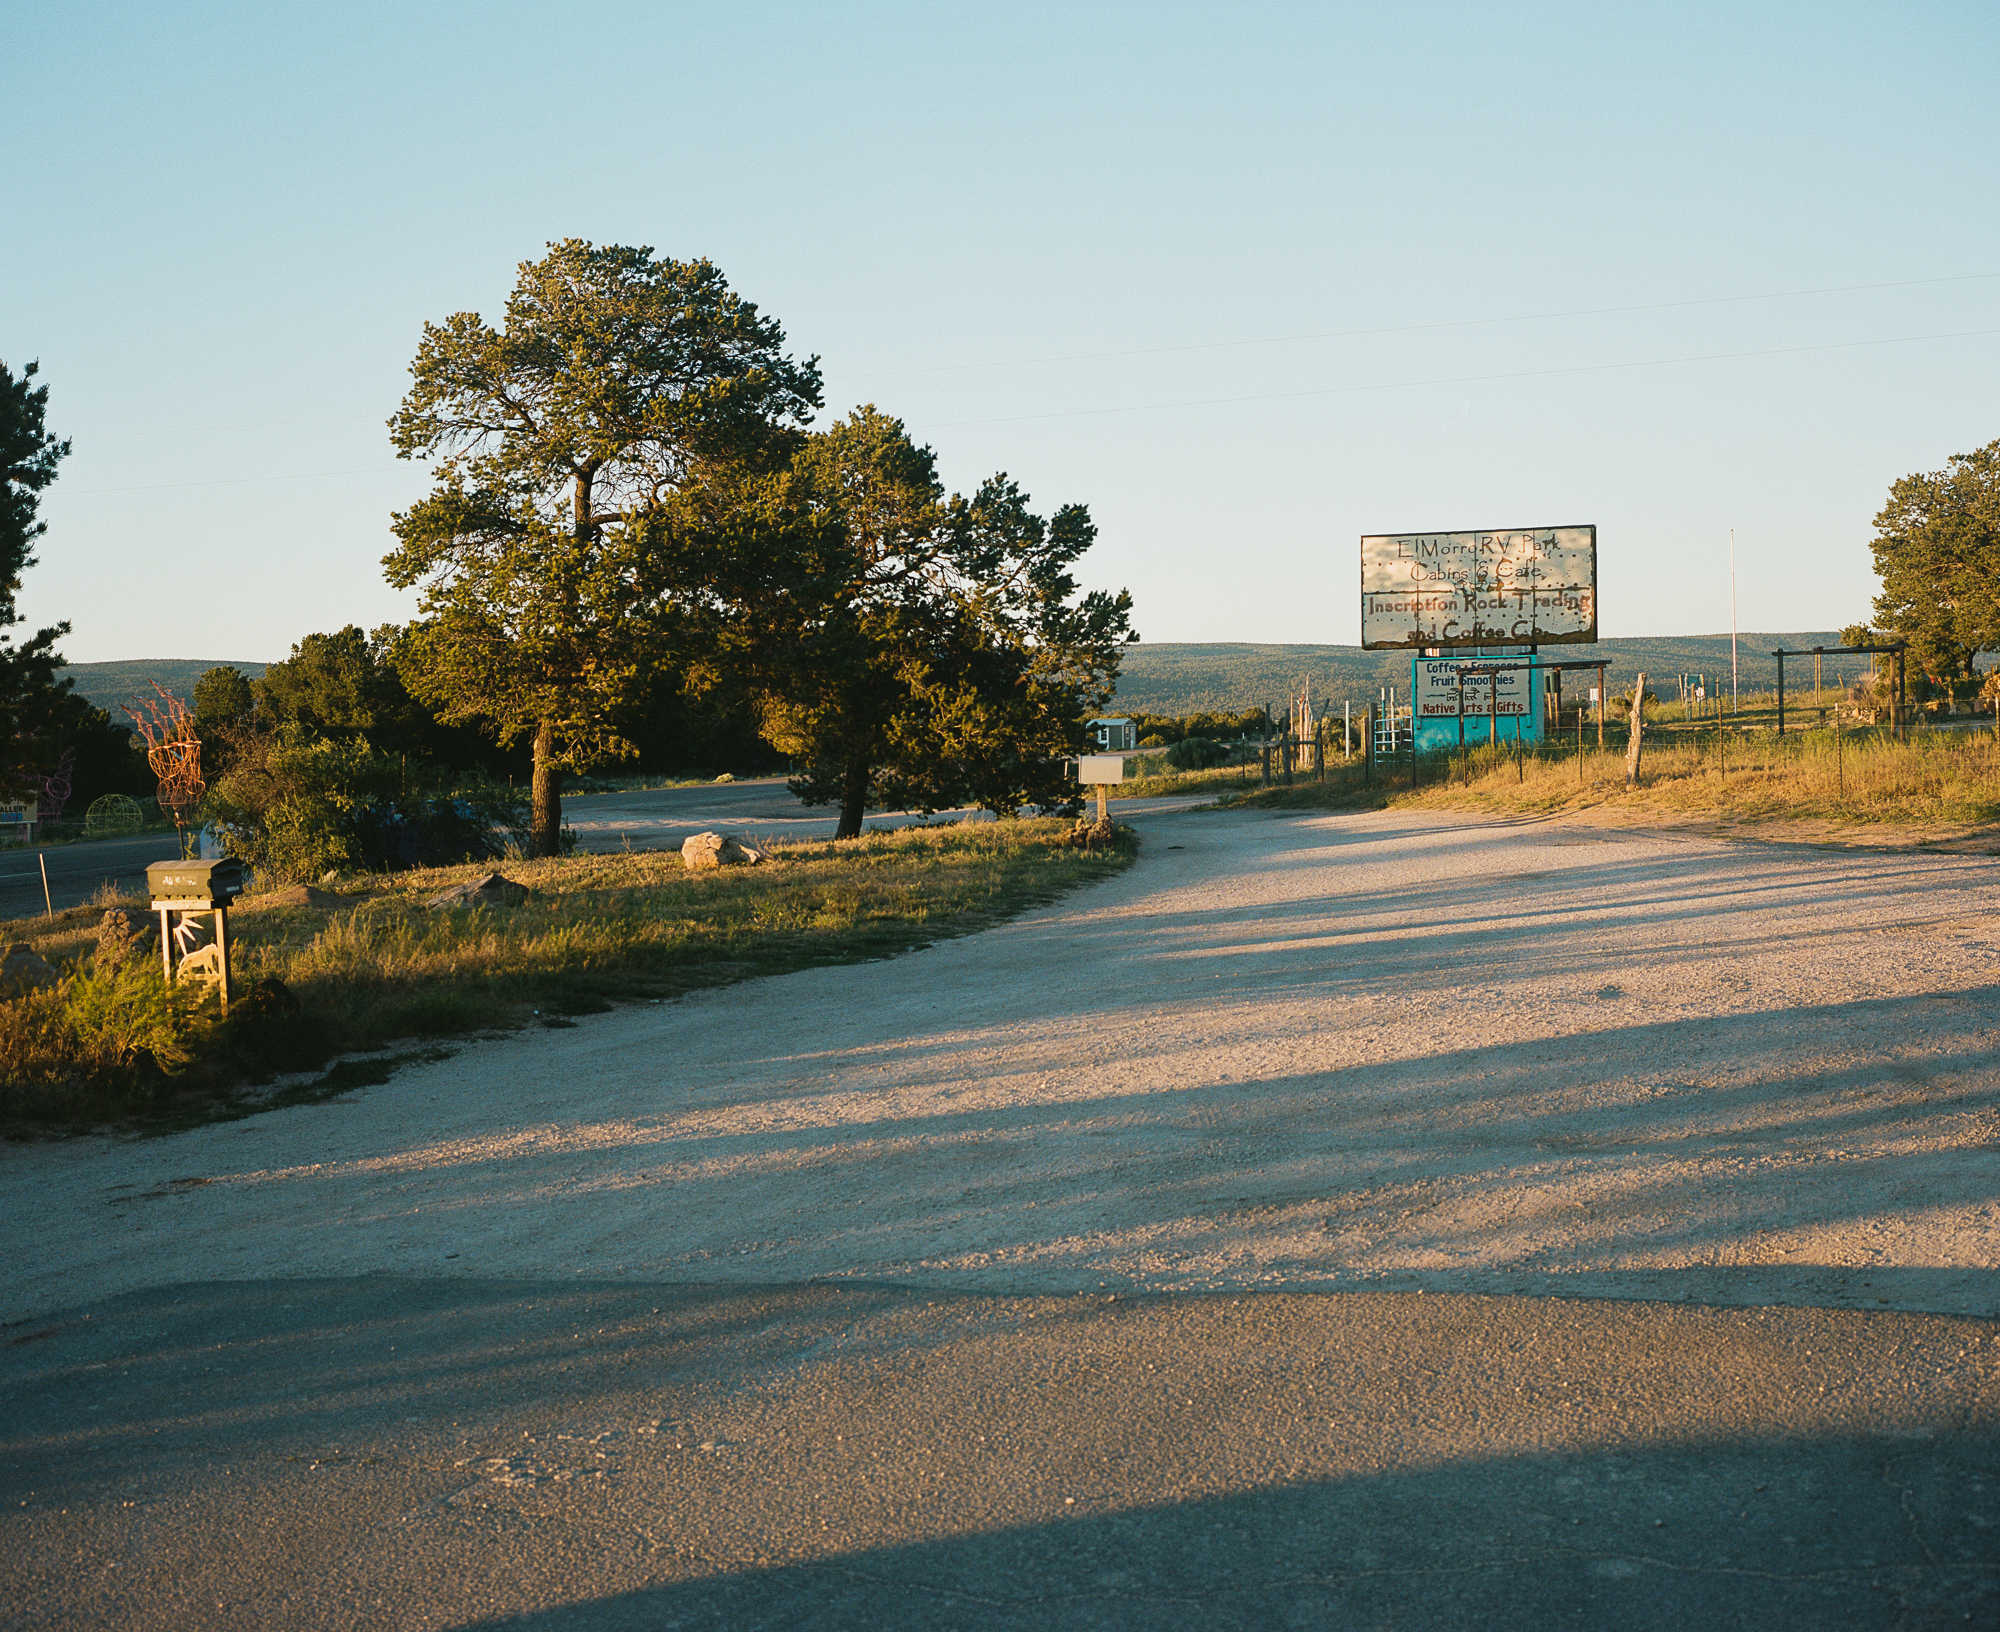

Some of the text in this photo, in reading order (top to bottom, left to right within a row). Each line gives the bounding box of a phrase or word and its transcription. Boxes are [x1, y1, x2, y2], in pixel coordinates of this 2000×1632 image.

[1421, 539, 1477, 557] Morro
[1481, 536, 1512, 555] RV
[1522, 533, 1561, 553] Park
[1411, 562, 1468, 581] Cabins
[1476, 561, 1488, 579] &
[1368, 590, 1591, 618] Inscription Rock Trading
[1407, 623, 1438, 640] and
[1442, 620, 1505, 641] Coffee
[1426, 662, 1461, 673] Coffee
[1431, 675, 1456, 687] Fruit
[1423, 703, 1456, 714] Native
[1497, 702, 1524, 713] Gifts
